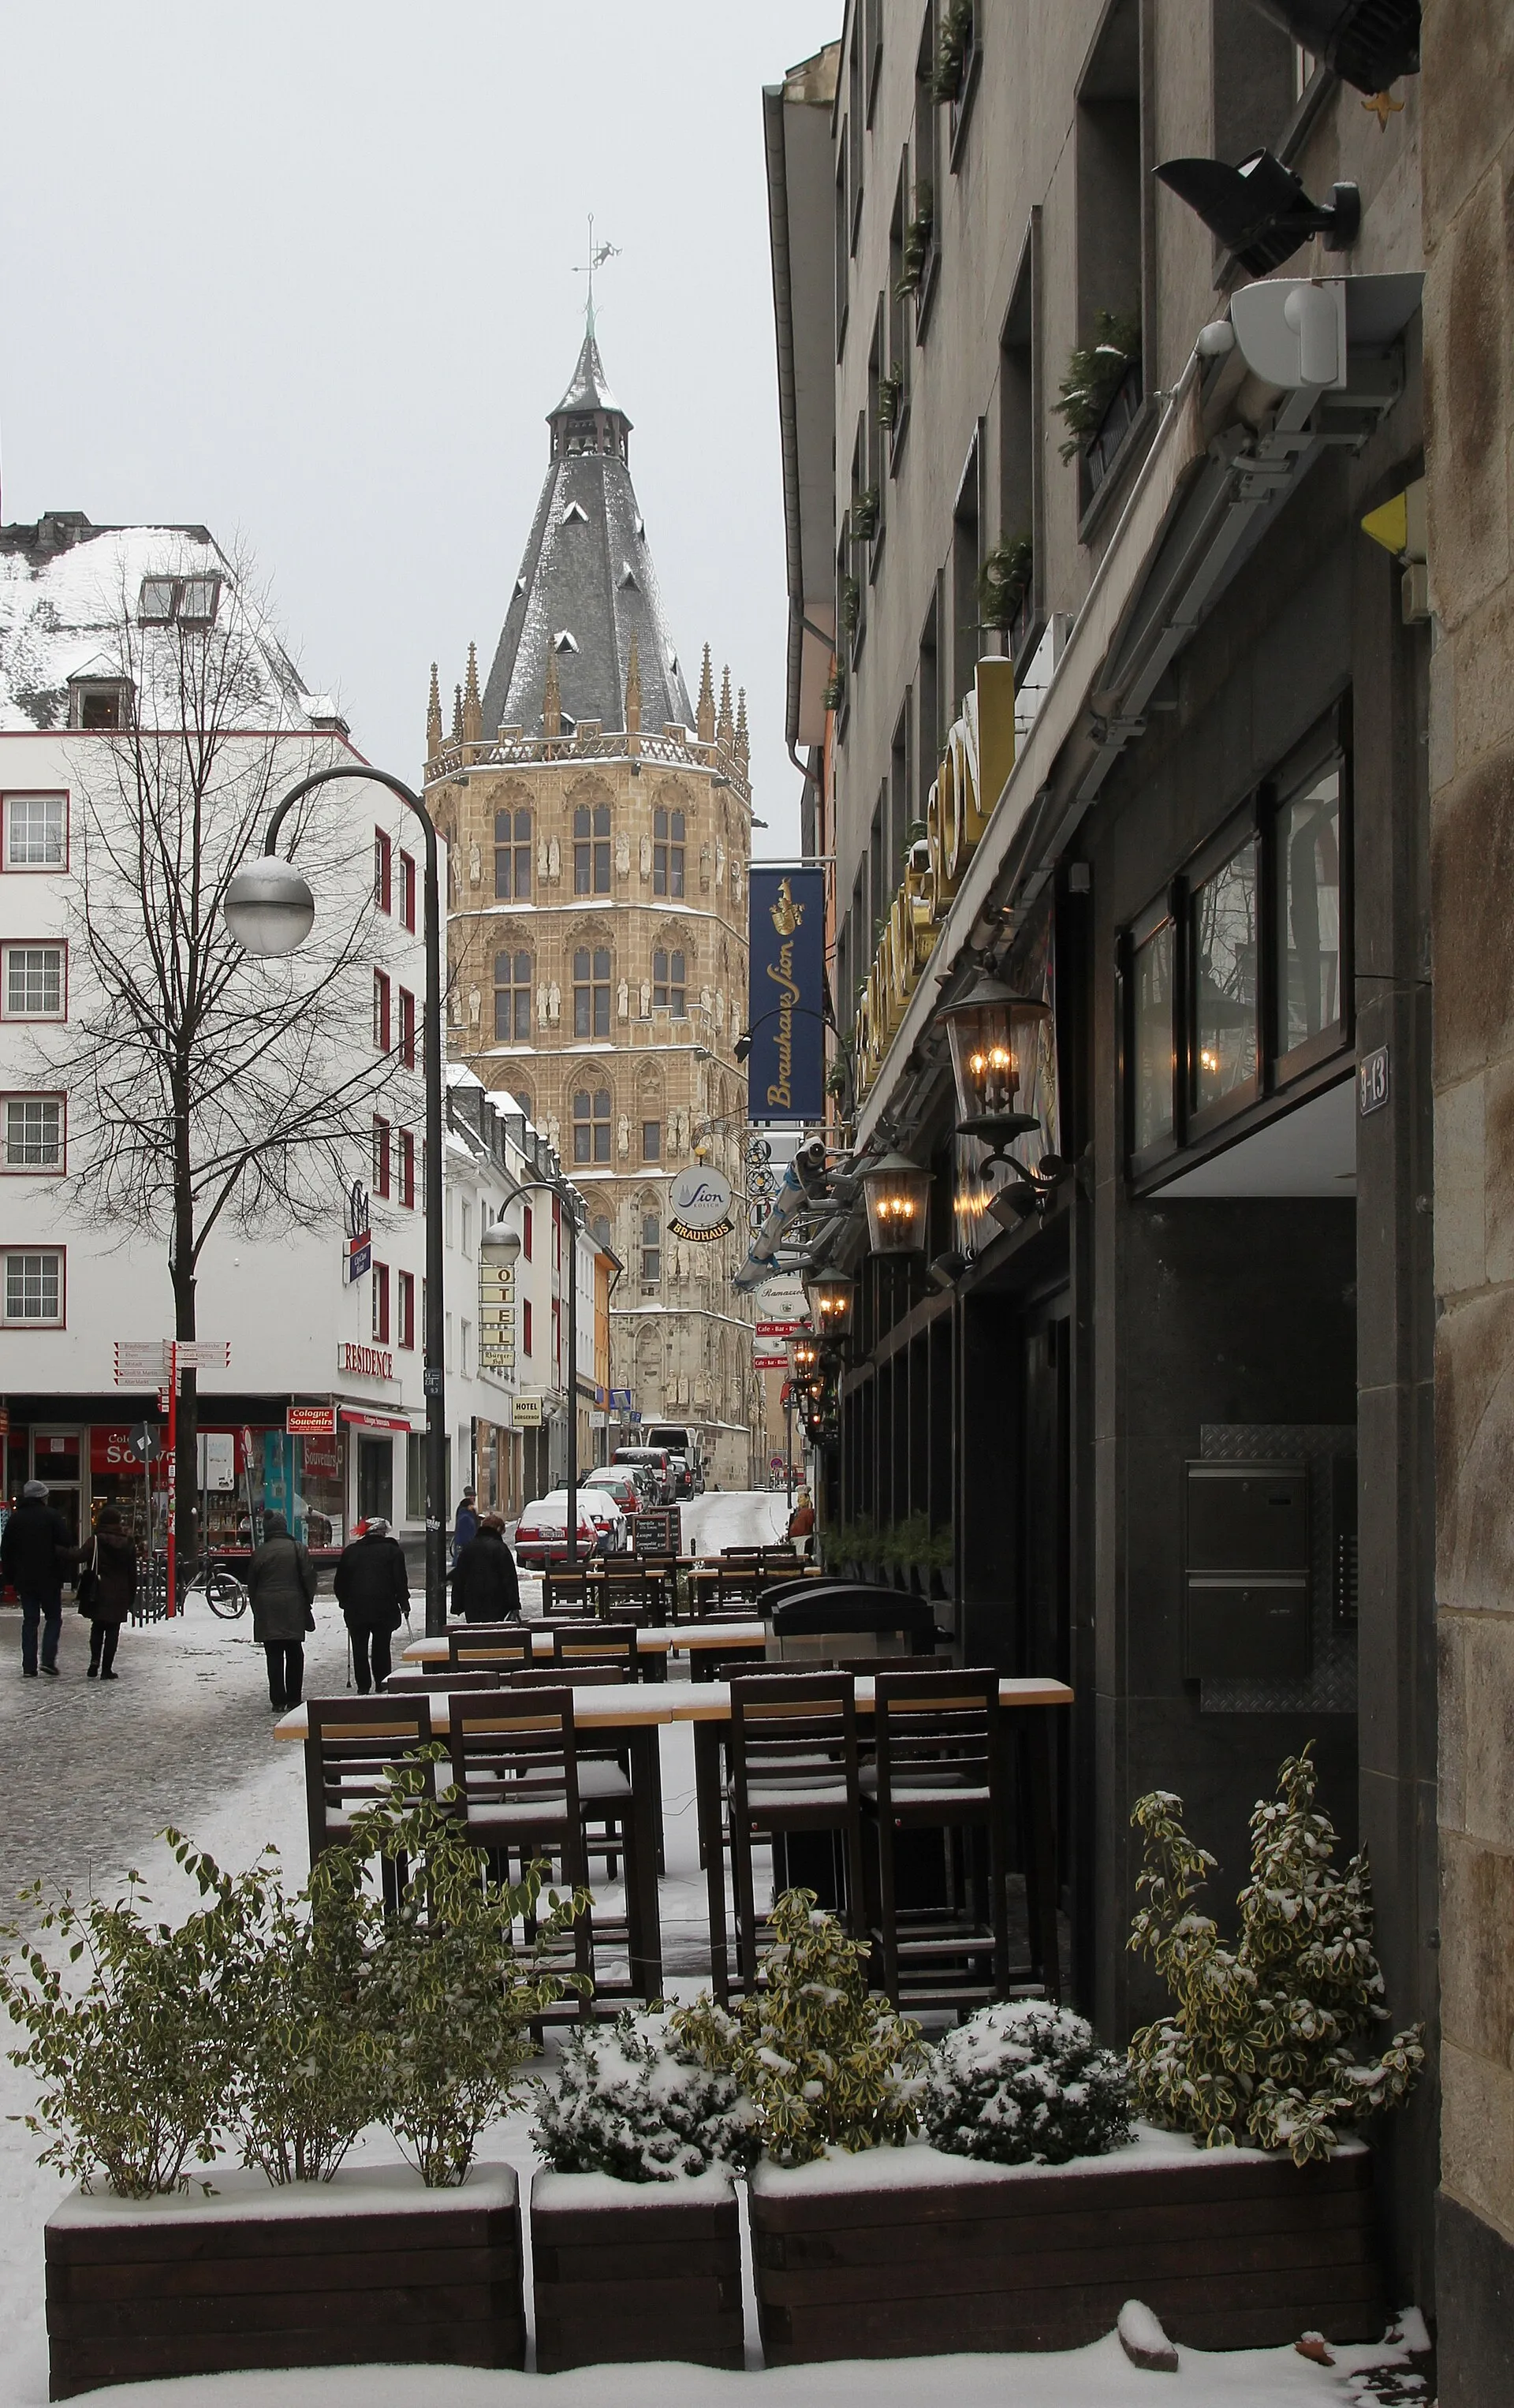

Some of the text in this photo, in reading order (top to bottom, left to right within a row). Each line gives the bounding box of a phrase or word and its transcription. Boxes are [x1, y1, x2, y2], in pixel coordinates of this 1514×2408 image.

[766, 939, 800, 1109] Brauhaus Sion
[678, 1183, 724, 1207] Sion
[673, 1223, 729, 1240] BRAUHAUS
[498, 1269, 510, 1344] OTEL
[345, 1343, 393, 1378] RESIDENCE
[293, 1410, 330, 1418] Cologne
[305, 1448, 336, 1467] Souvenirs
